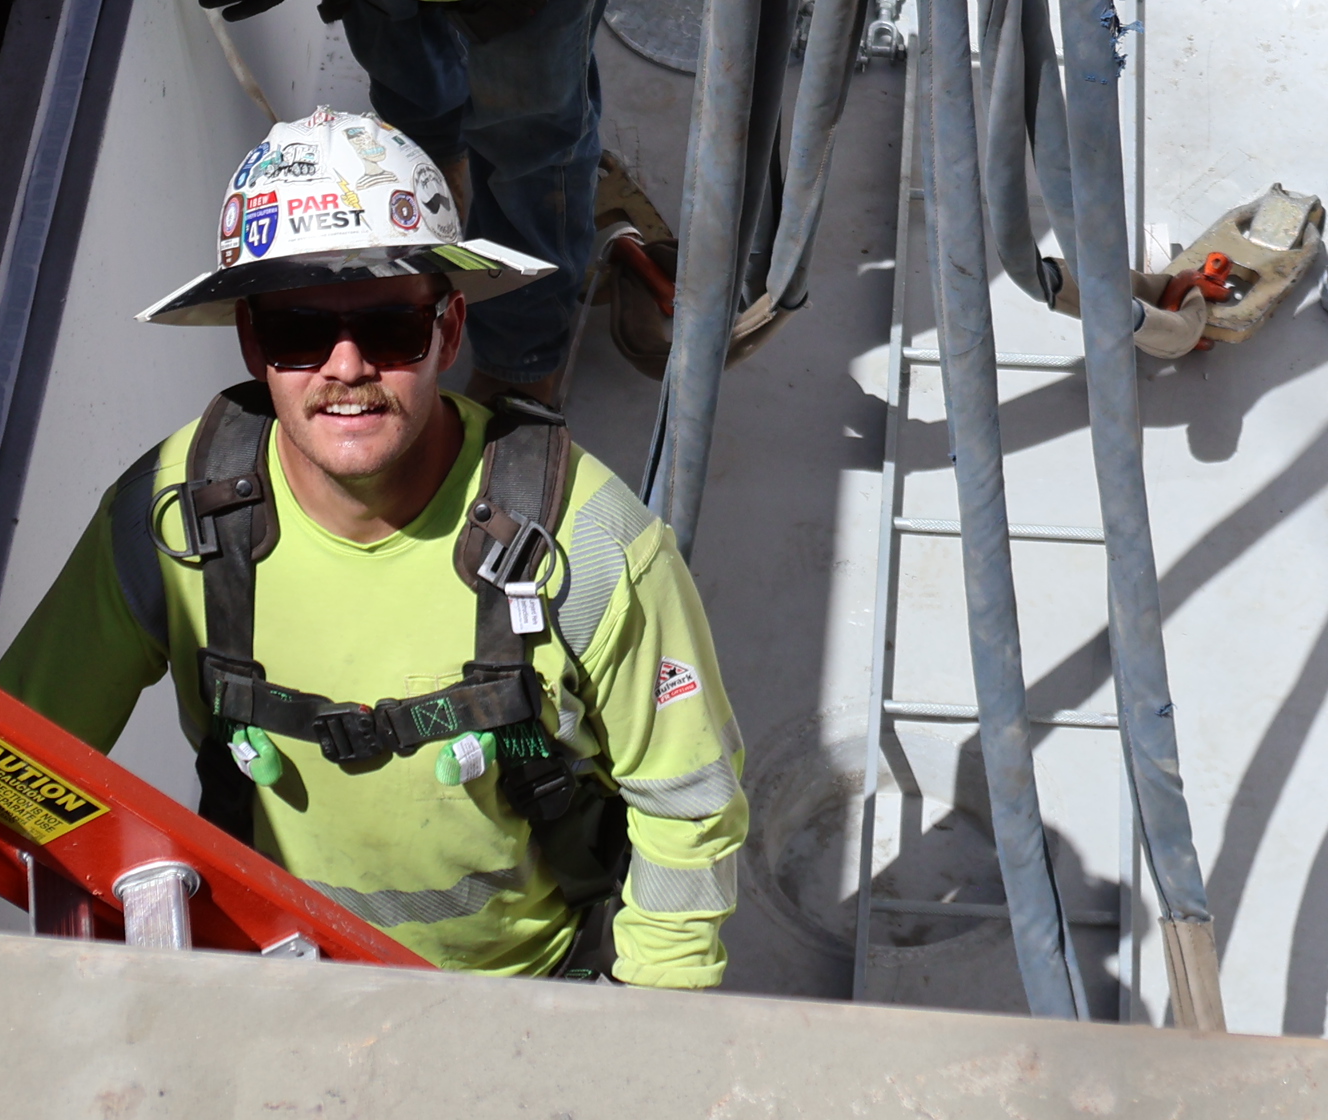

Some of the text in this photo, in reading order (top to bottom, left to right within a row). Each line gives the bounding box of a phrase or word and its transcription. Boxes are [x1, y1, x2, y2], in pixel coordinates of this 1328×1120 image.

[249, 195, 269, 208] IBEW
[287, 193, 339, 216] PAR
[248, 217, 271, 246] 47
[289, 209, 365, 235] WEST
[30, 806, 42, 815] IS
[41, 813, 62, 827] NOT
[33, 818, 55, 833] USE
